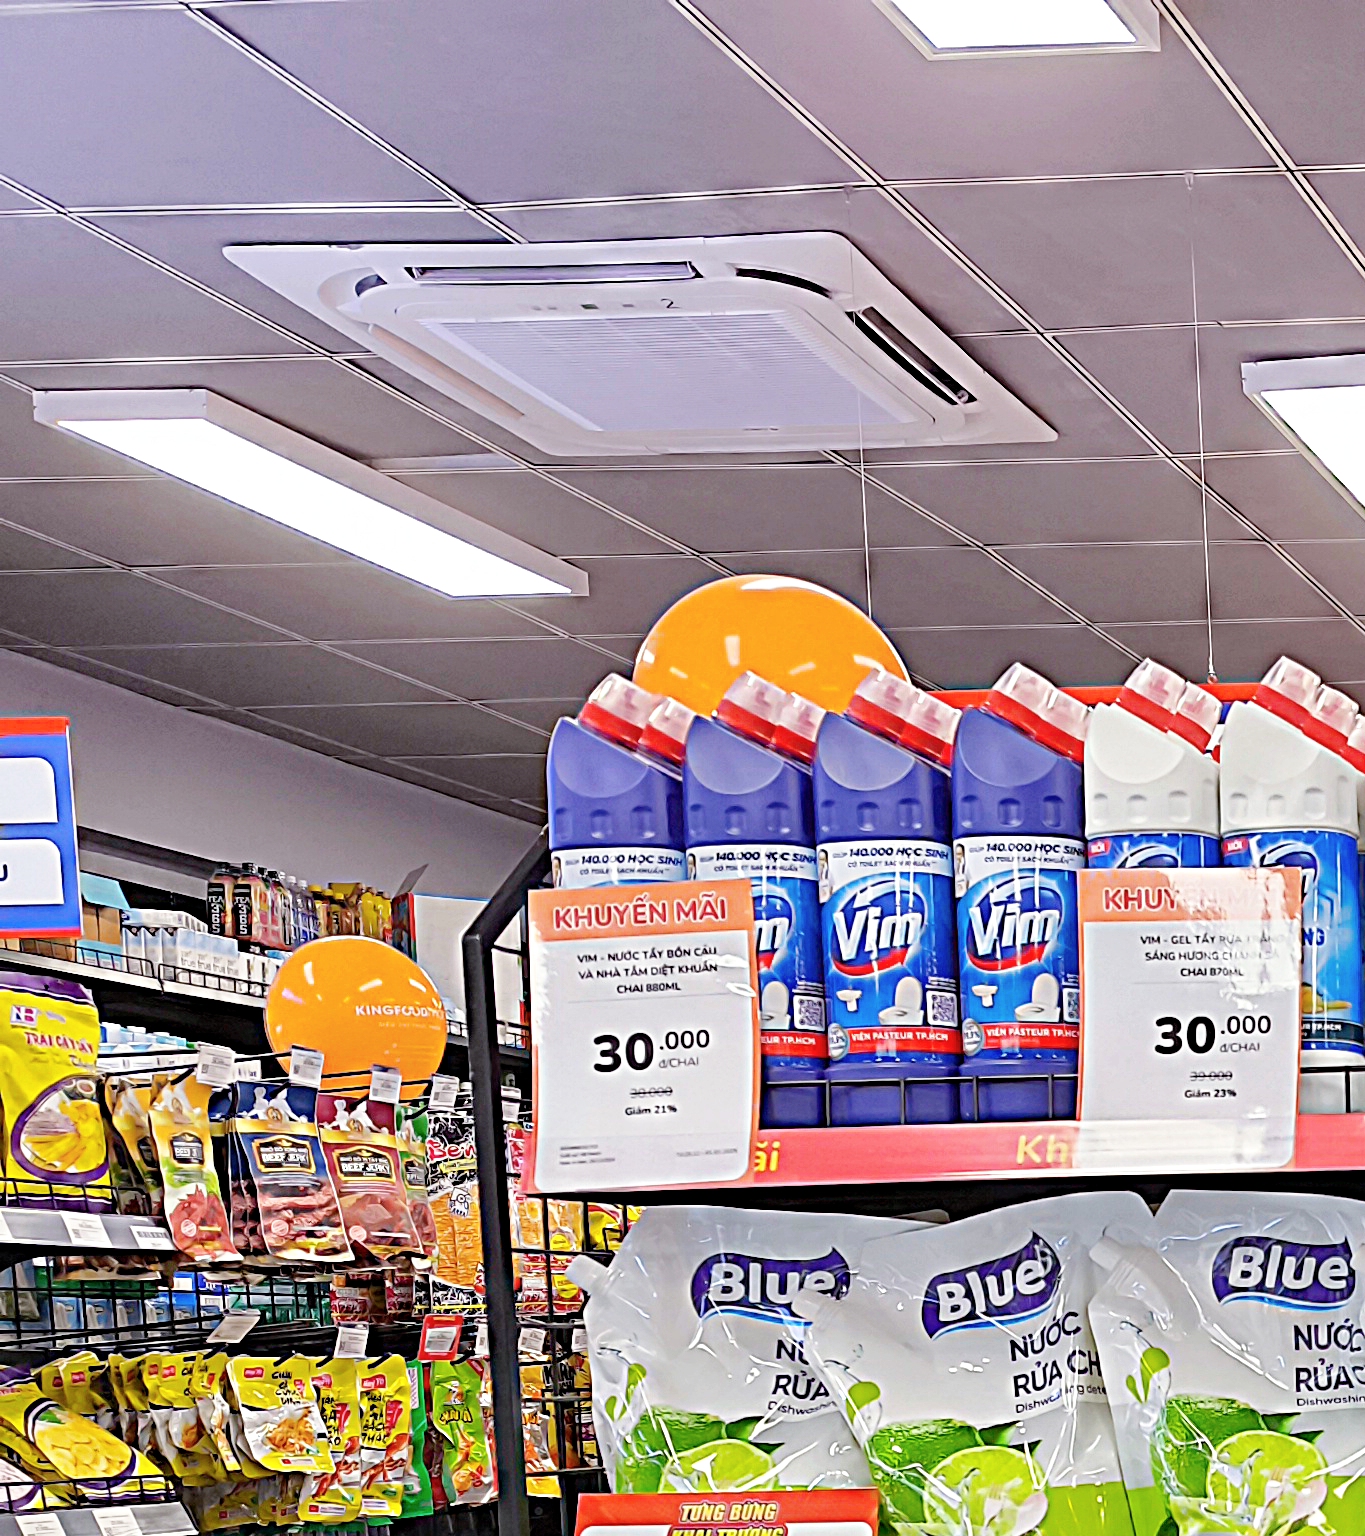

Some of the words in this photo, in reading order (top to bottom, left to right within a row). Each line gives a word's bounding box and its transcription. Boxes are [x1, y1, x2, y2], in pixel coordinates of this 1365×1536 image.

[555, 894, 667, 930] KHUYẾN
[676, 892, 728, 923] MÃI
[969, 902, 1061, 958] Vim
[831, 902, 925, 960] Vim
[578, 955, 597, 963] VIM
[643, 948, 663, 959] TẨY
[578, 968, 593, 979] VÀ
[597, 967, 620, 978] NHÀ
[651, 966, 675, 976] DIỆT
[617, 984, 644, 993] CHAI
[646, 982, 681, 992] 880ML
[593, 1032, 654, 1073] 30
[659, 1029, 710, 1050] .000
[1155, 1016, 1216, 1055] 30
[1220, 1016, 1271, 1034] .000
[659, 1057, 699, 1068] đ/CHAI
[654, 1105, 677, 1114] 21%
[1214, 1089, 1236, 1098] 23%
[1228, 1247, 1353, 1291] Blue
[938, 1258, 1048, 1323] Blue
